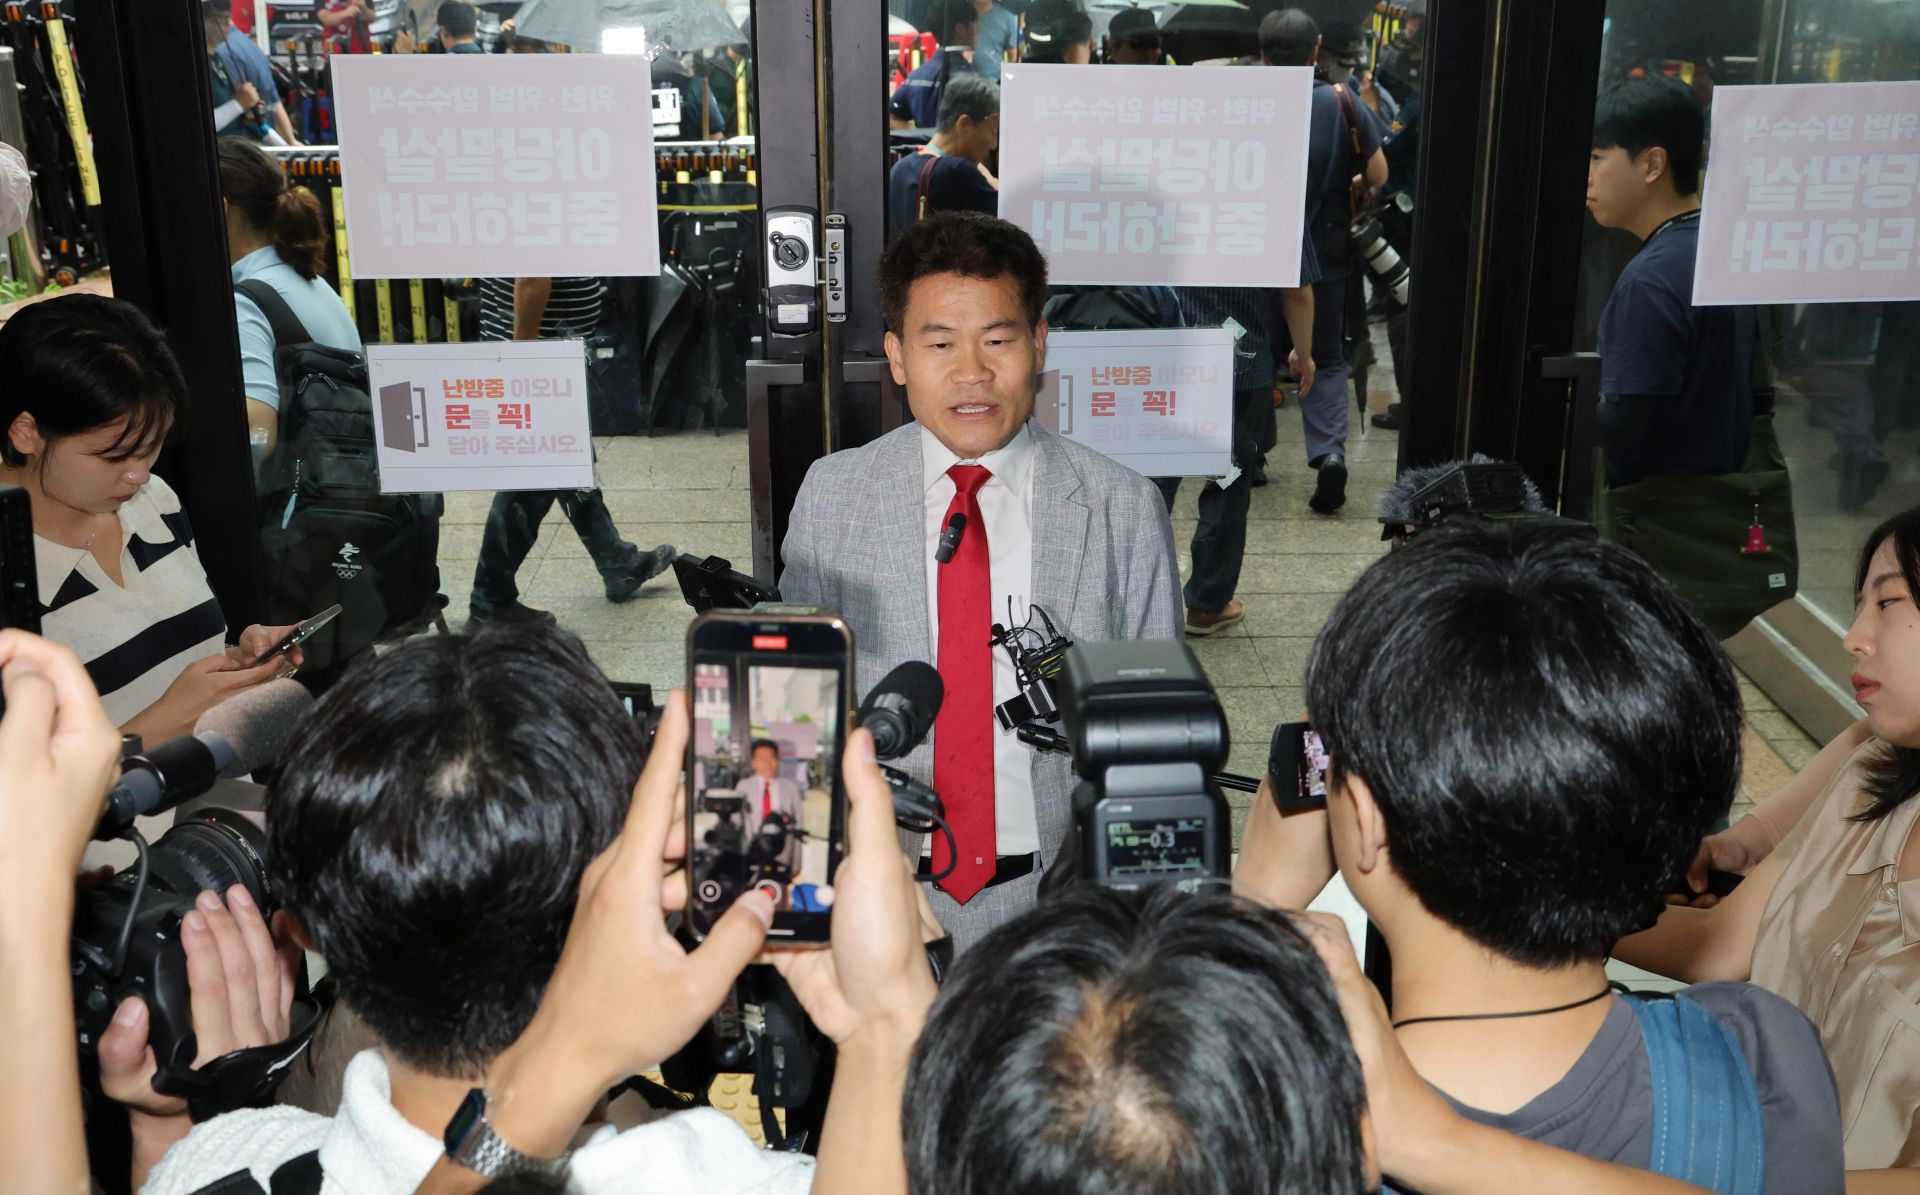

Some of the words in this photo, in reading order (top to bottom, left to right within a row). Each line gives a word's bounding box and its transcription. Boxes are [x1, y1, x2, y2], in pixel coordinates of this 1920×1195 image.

[1091, 365, 1152, 386] 난방중
[442, 378, 505, 399] 난방중
[510, 378, 572, 398] 이오니
[1142, 390, 1176, 416] 꼭!
[445, 403, 490, 430] 문을
[497, 403, 532, 430] 꼭!
[447, 435, 490, 456] 닫아
[495, 434, 583, 456] 주십시오.
